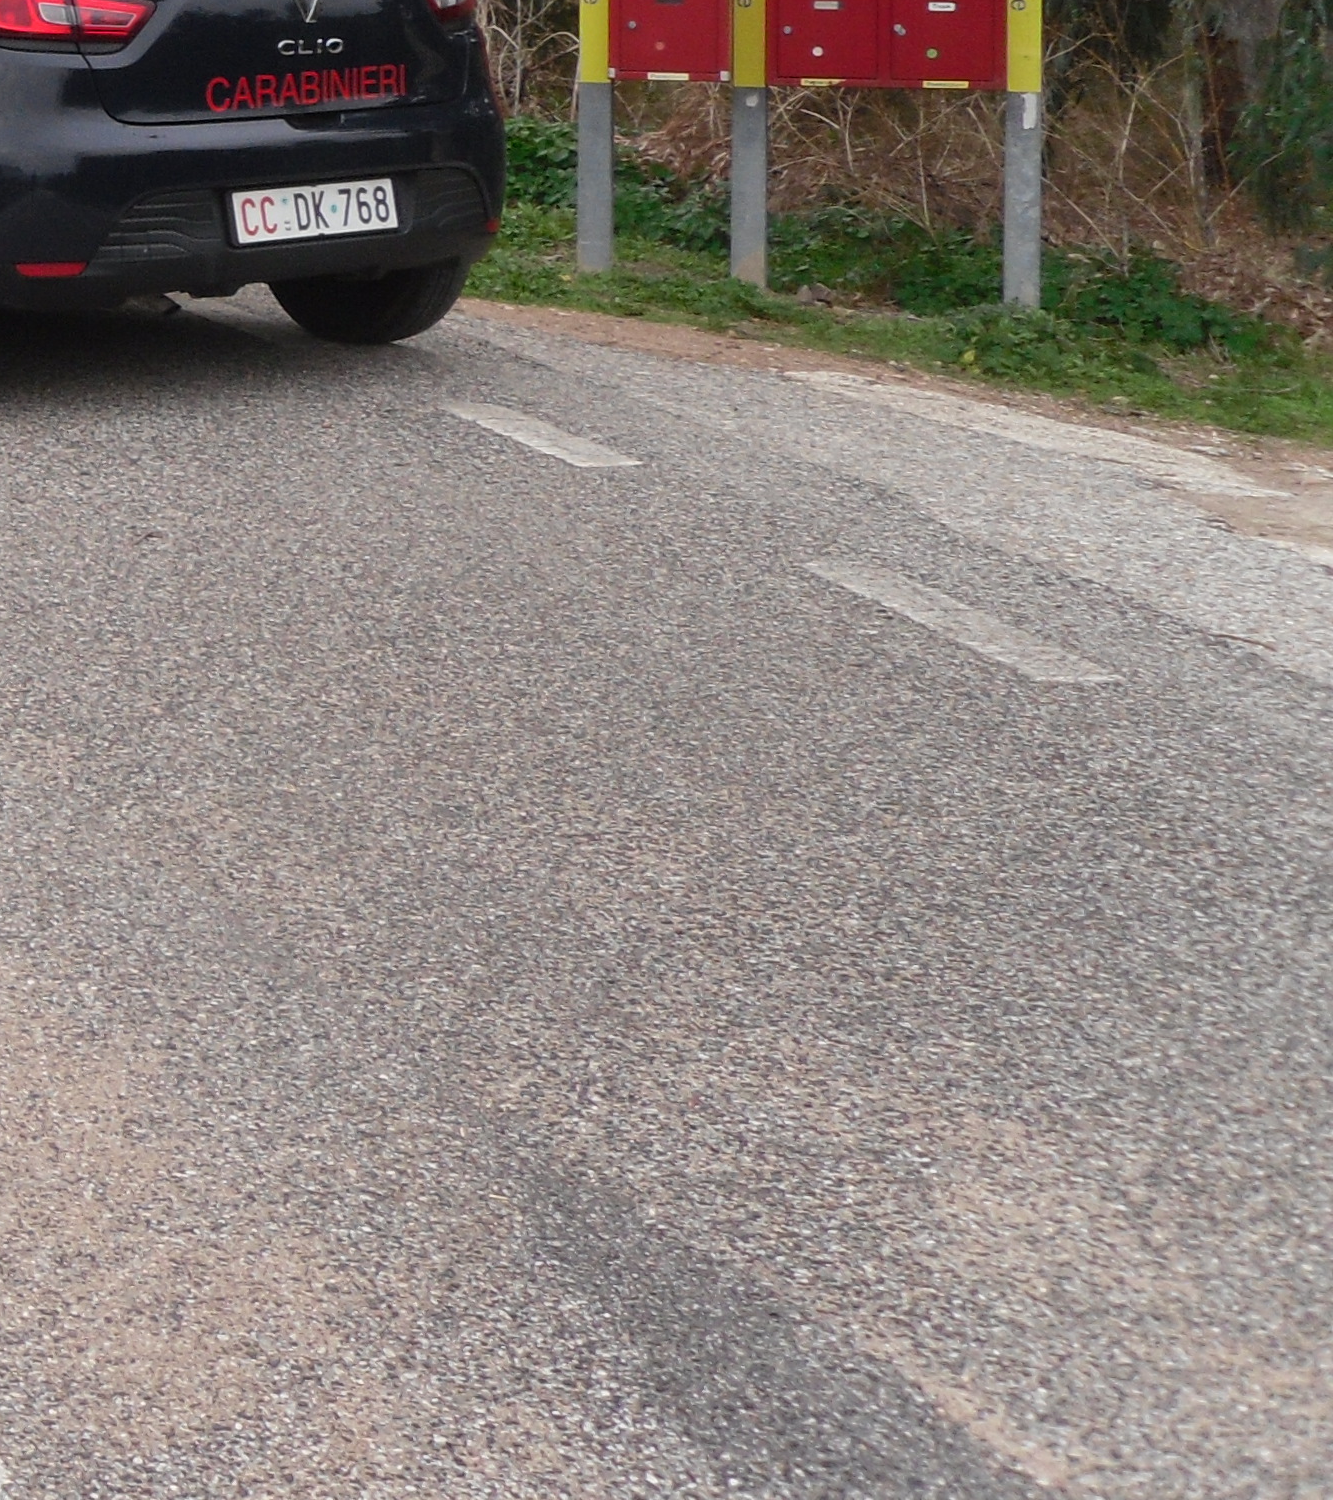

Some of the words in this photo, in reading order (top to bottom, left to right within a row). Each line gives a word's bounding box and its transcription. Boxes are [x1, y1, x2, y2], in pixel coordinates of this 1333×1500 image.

[277, 38, 344, 56] CLIO
[205, 64, 407, 112] CARABINIERI
[241, 196, 278, 236] CC
